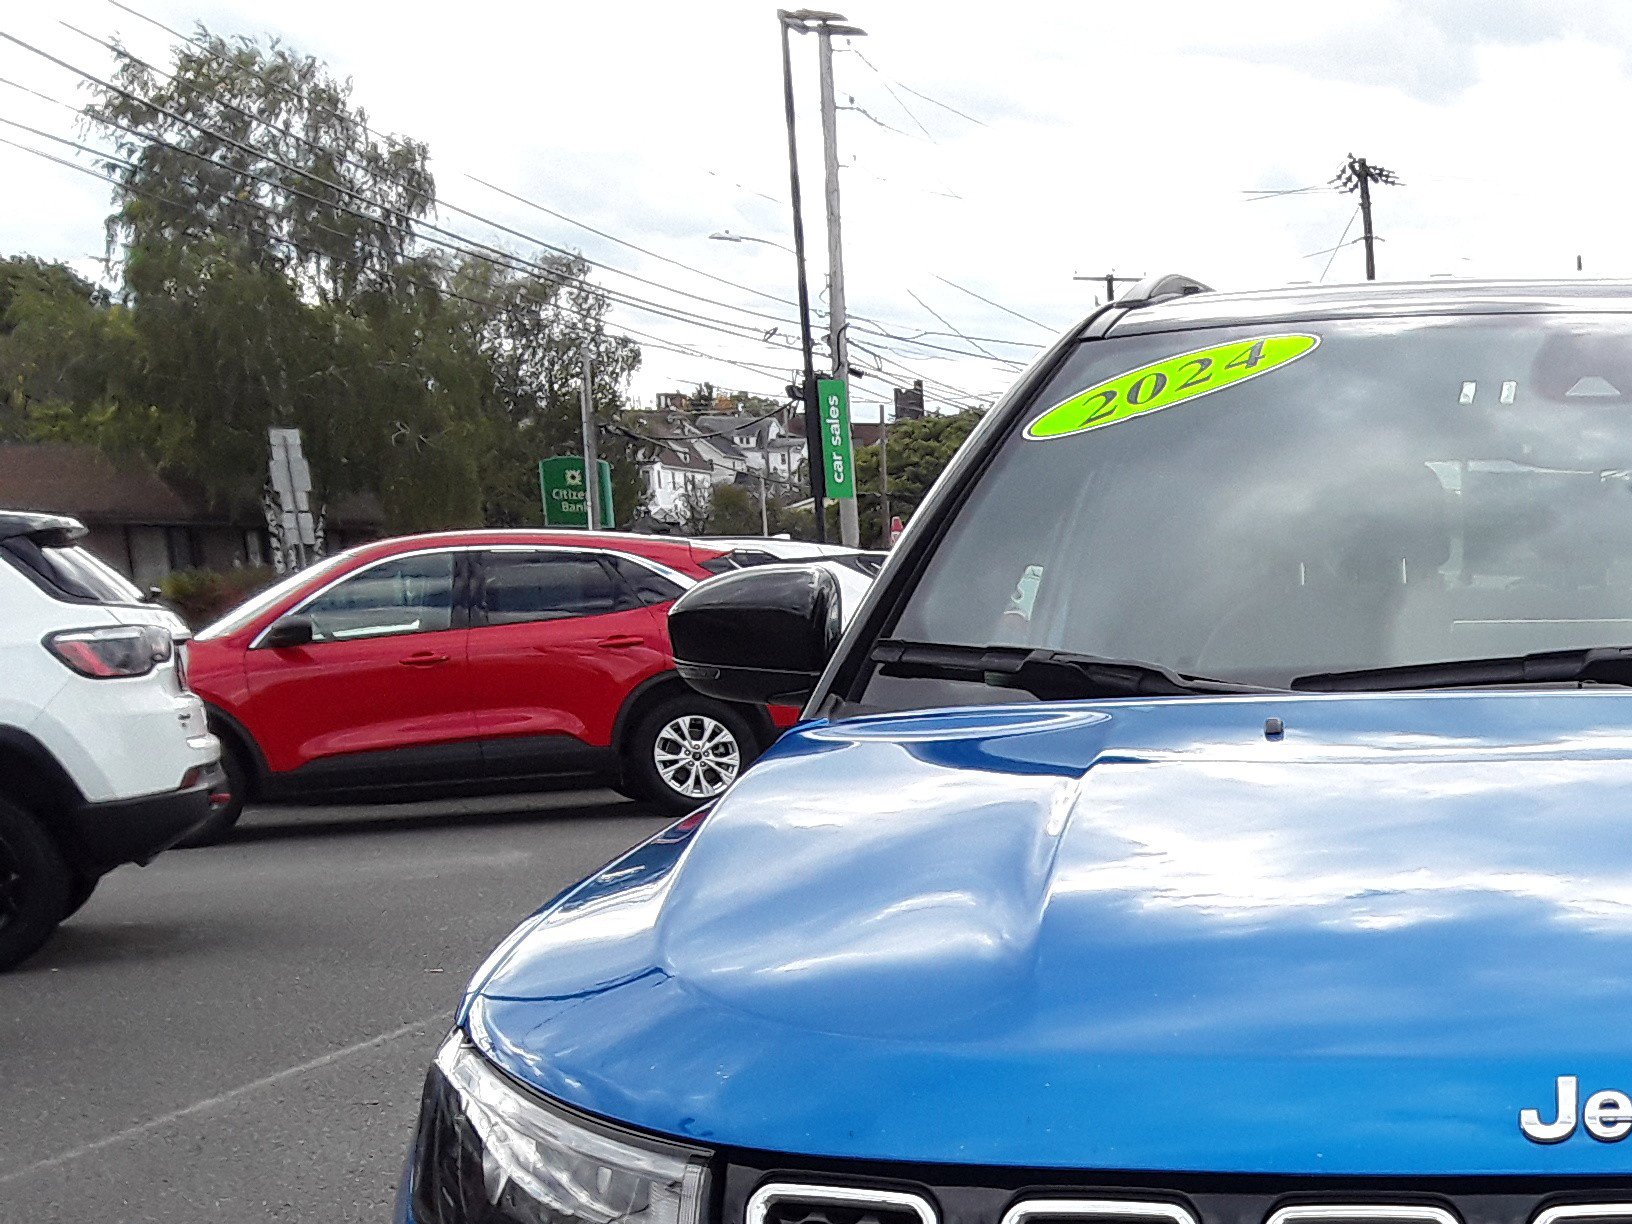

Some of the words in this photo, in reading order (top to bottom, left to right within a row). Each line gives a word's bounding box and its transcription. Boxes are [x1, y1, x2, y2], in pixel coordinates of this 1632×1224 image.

[1078, 339, 1266, 427] 2024
[826, 395, 842, 446] sales
[832, 452, 845, 484] car
[552, 488, 587, 500] Citize
